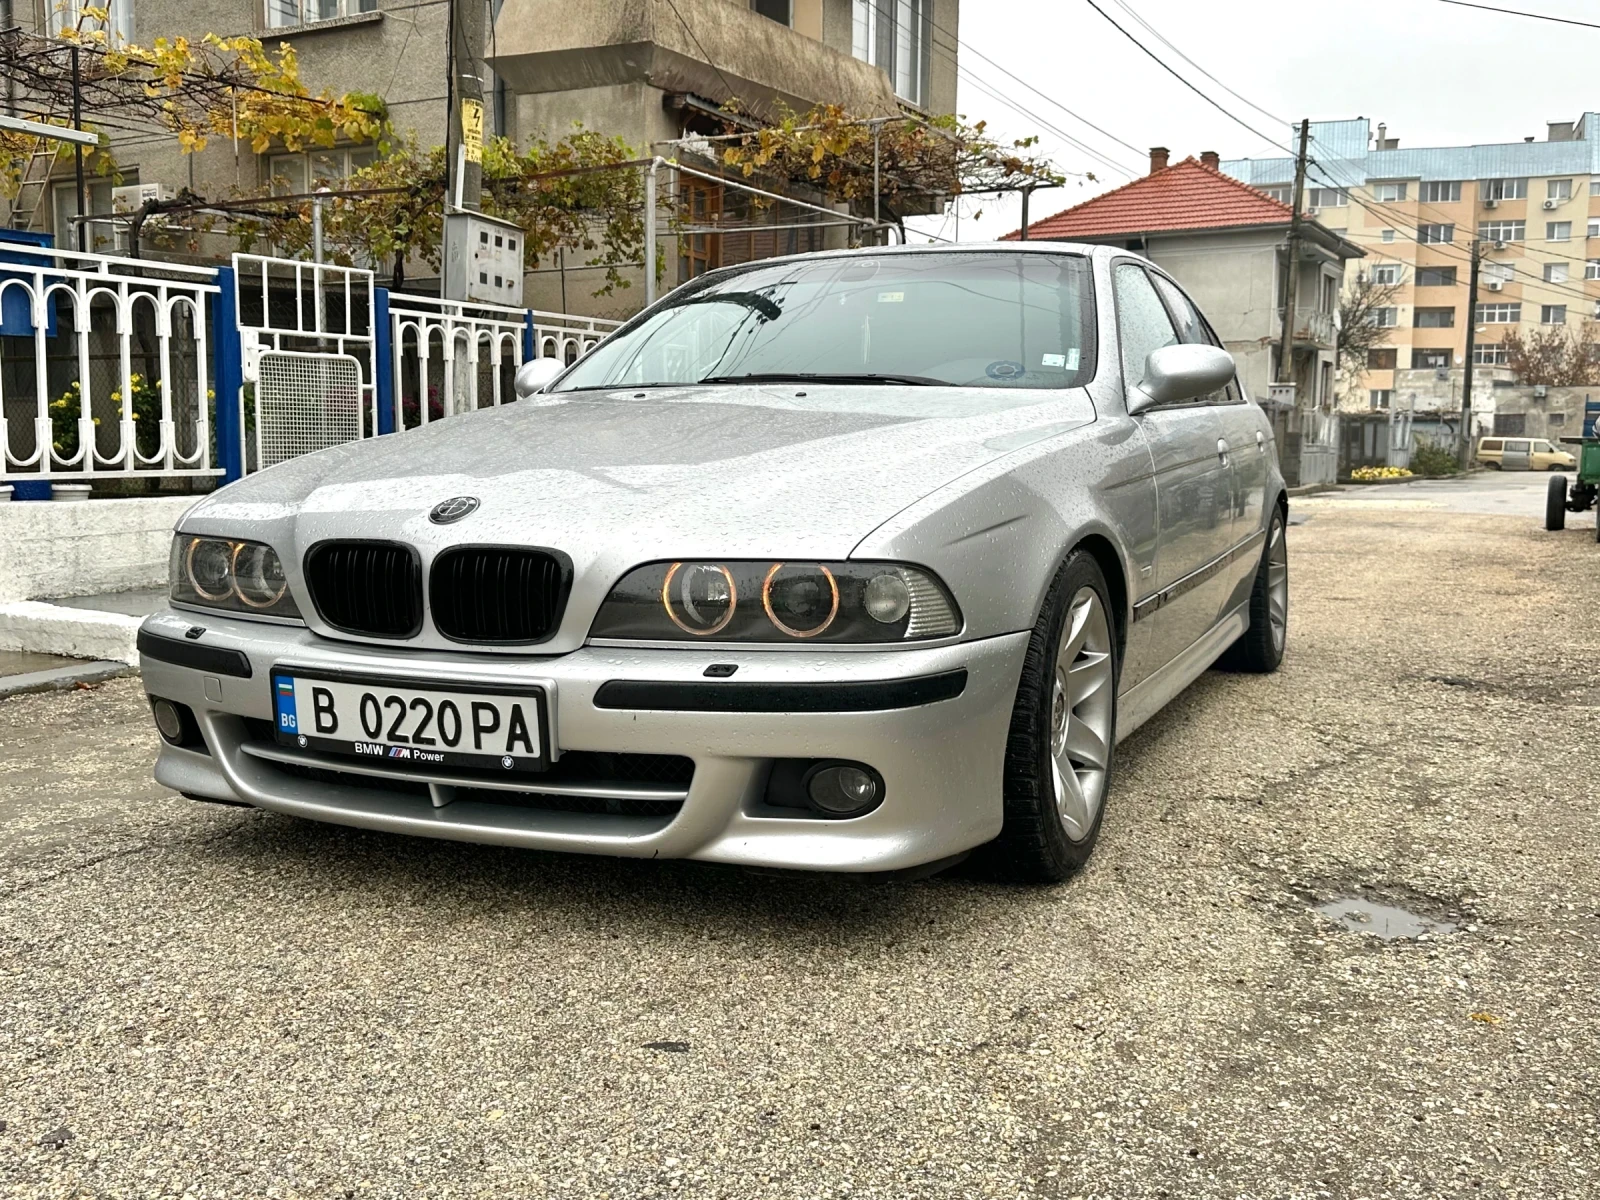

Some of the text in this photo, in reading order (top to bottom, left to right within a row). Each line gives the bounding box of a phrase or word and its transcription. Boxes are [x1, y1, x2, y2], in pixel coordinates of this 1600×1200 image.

[281, 713, 296, 727] BG
[312, 686, 339, 734] B
[354, 742, 384, 756] BMW
[413, 750, 444, 762] Power
